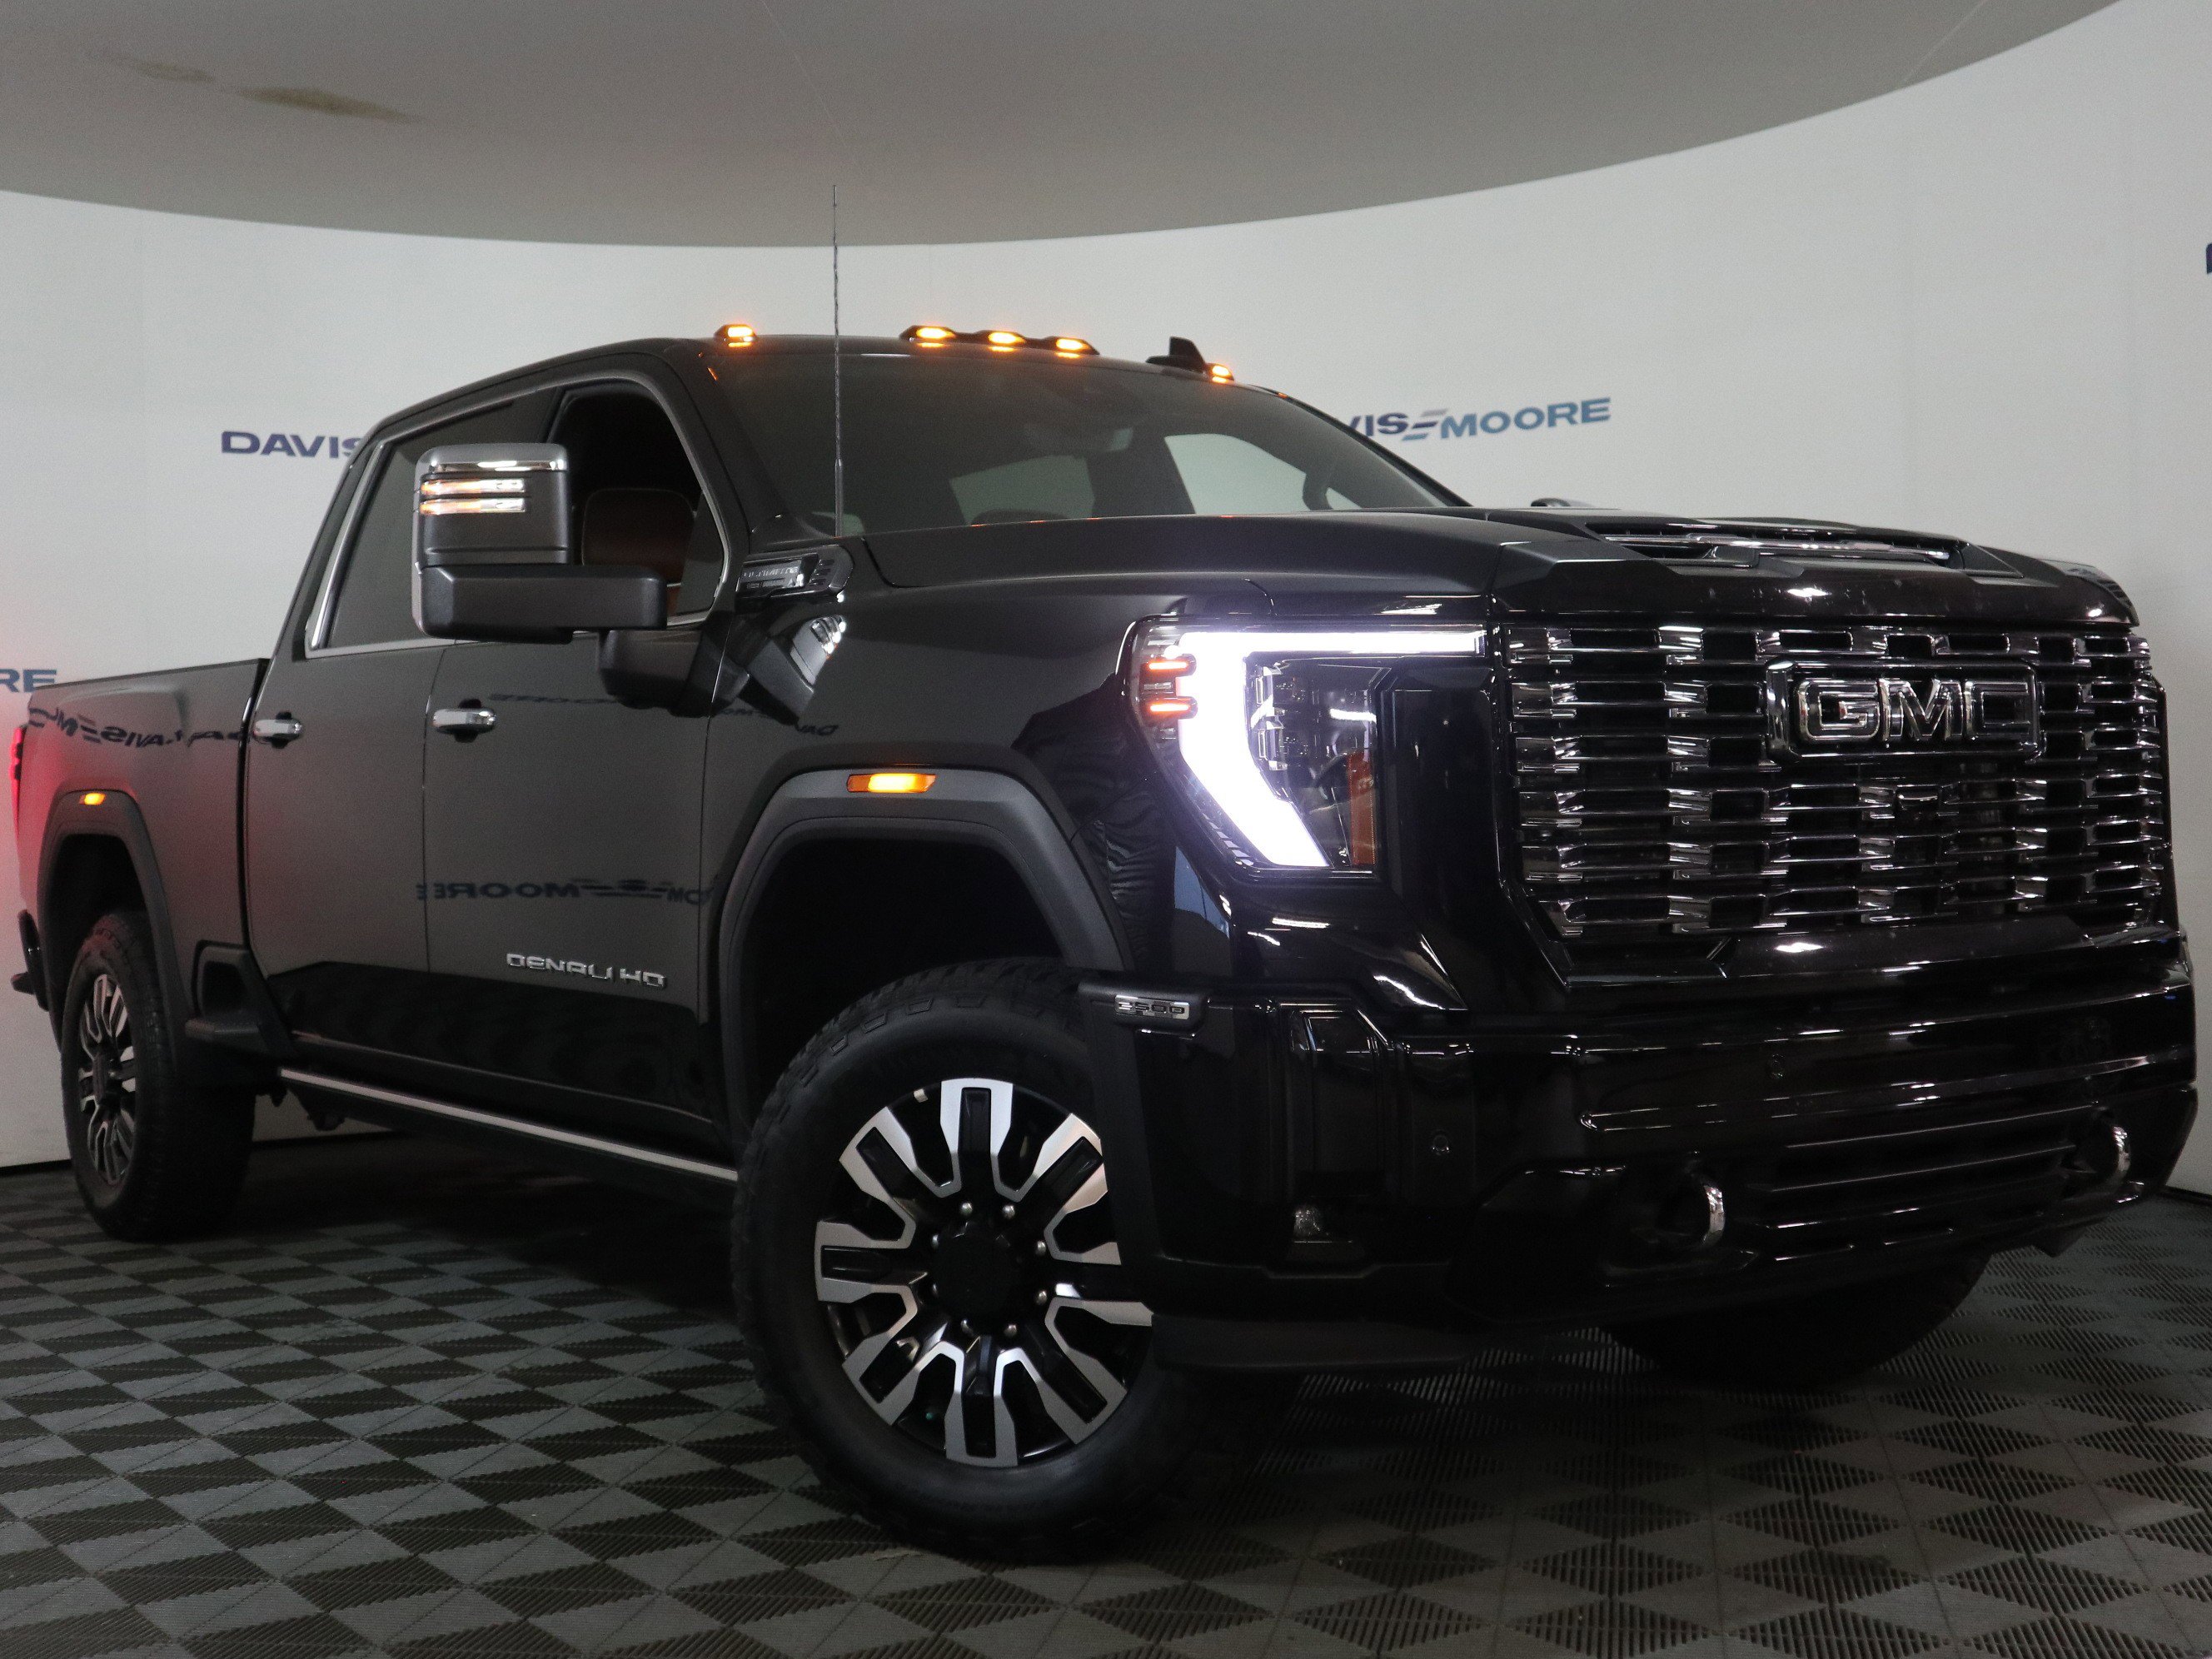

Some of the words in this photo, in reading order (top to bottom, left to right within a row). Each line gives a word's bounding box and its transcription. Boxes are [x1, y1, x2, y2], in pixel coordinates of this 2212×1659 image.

[1441, 397, 1612, 439] MOORE
[1796, 676, 2032, 743] GMC
[506, 953, 612, 981] DENALI
[620, 968, 666, 988] HD
